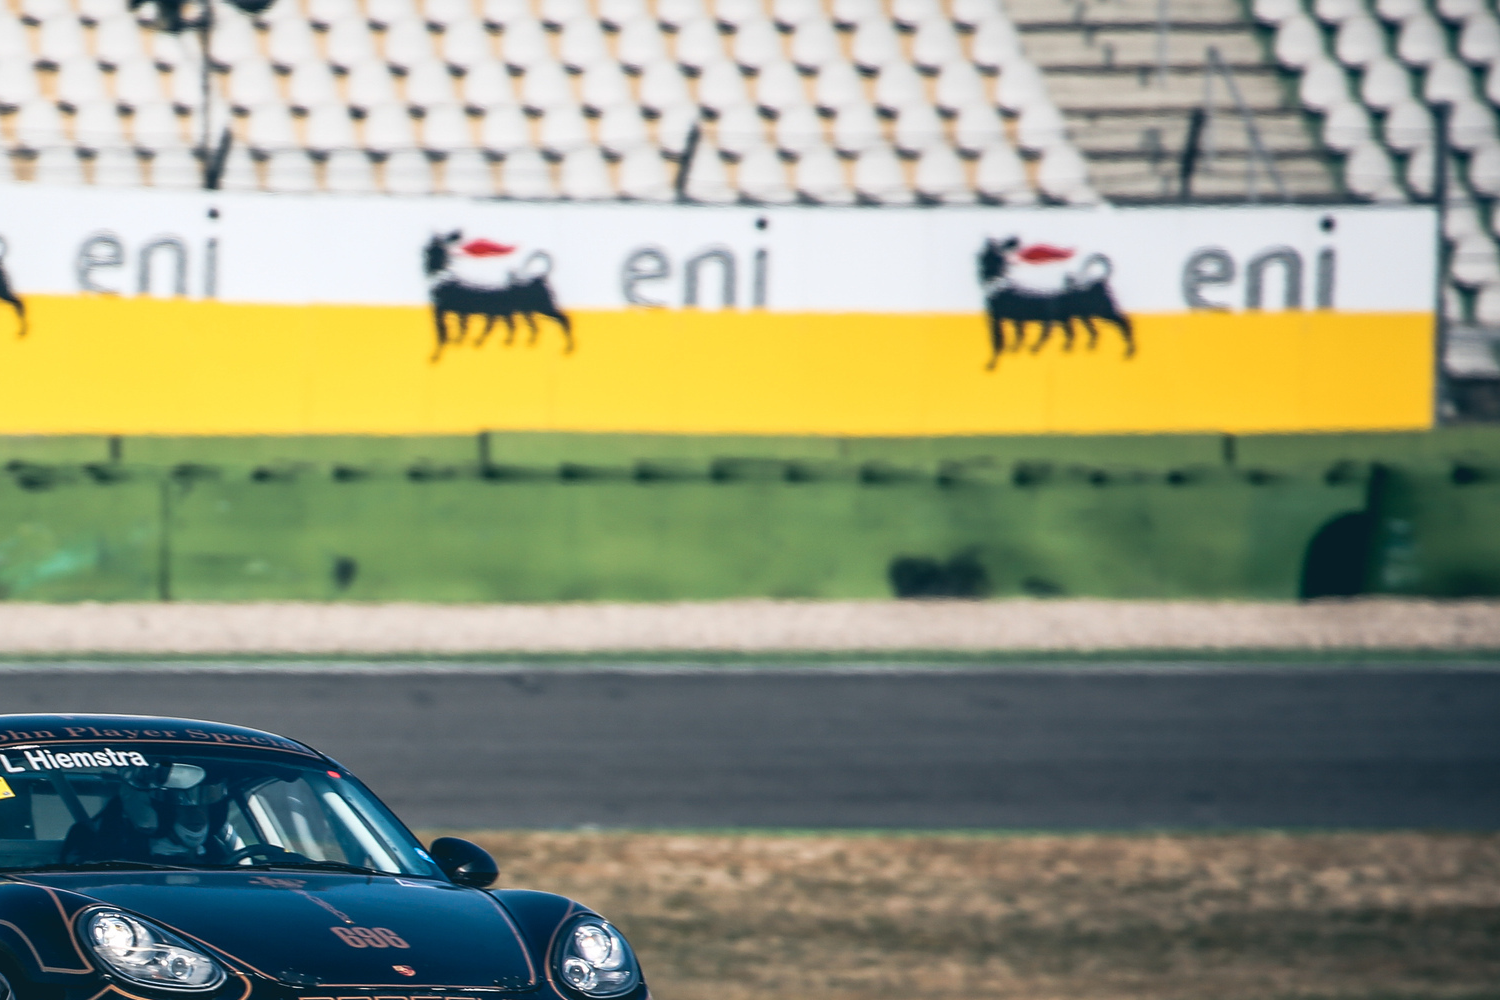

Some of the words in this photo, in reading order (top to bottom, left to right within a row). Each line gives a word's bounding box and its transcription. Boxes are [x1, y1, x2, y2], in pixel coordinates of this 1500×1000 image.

[76, 208, 220, 297] eni
[621, 216, 769, 309] eni
[1182, 215, 1337, 311] eni
[23, 747, 150, 771] Hiemstra
[62, 726, 177, 739] Player
